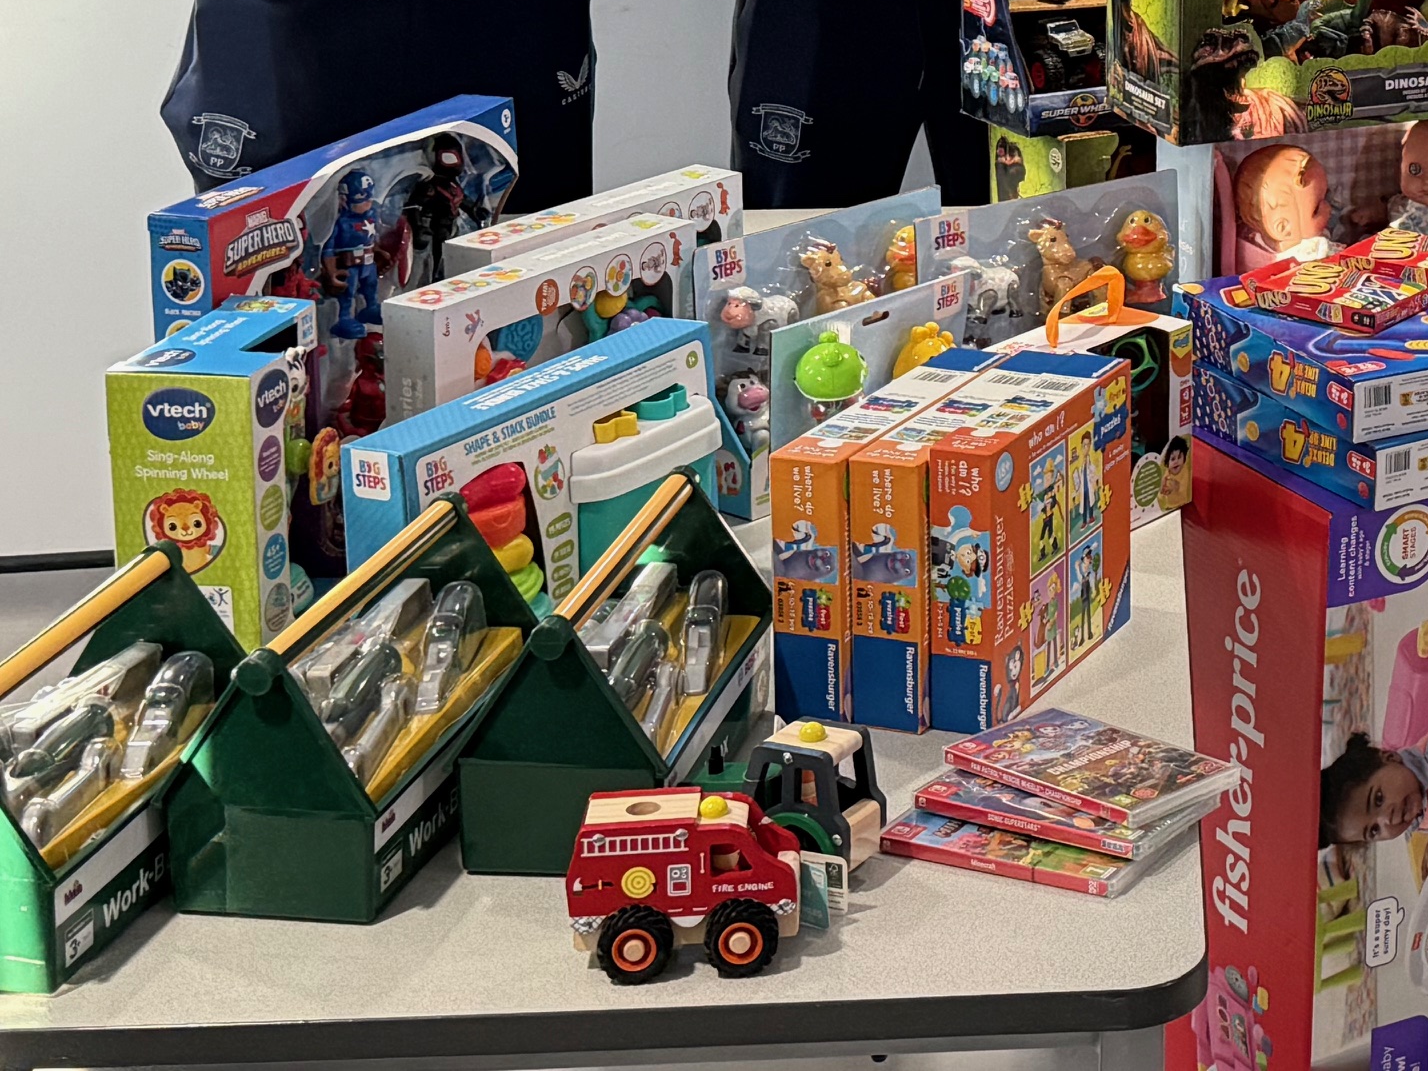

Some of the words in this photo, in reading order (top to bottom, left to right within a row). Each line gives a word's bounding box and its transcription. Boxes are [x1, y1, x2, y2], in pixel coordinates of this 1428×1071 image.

[1124, 82, 1154, 105] DINOSAUR
[1041, 106, 1079, 119] SUPER
[1308, 102, 1352, 121] DINOSAUR
[227, 231, 263, 265] SUPER
[265, 223, 294, 249] HERO
[935, 232, 966, 251] STEPS
[1371, 227, 1421, 261] UNO
[237, 245, 287, 272] ADVENTURES
[712, 260, 744, 279] STEPS
[1340, 256, 1375, 271] UNO
[1288, 261, 1345, 294] UNO
[936, 292, 960, 311] STEPS
[1257, 290, 1292, 310] UNO
[258, 380, 287, 409] vtech
[1295, 378, 1317, 398] DELUXE
[147, 402, 210, 418] vtech
[178, 421, 204, 430] baby
[464, 434, 493, 456] SHAPE
[501, 423, 526, 443] STACK
[526, 407, 557, 432] BUNDLE
[1100, 413, 1121, 439] puzzles
[1028, 430, 1043, 449] who
[147, 450, 214, 464] Sing-Along
[959, 460, 968, 479] am
[1309, 448, 1336, 467] DELUXE
[135, 466, 187, 480] Spinning
[191, 468, 229, 481] Wheel
[355, 473, 387, 490] STEPS
[424, 472, 455, 496] STEPS
[805, 465, 813, 502] where
[884, 468, 892, 503] where
[971, 467, 980, 492] who
[793, 483, 804, 512] live?
[873, 486, 884, 515] live?
[1350, 515, 1359, 558] changes
[1402, 528, 1411, 560] SMART
[1338, 536, 1348, 581] Learning
[993, 515, 1008, 647] Ravensburger
[1348, 557, 1356, 598] content
[1003, 575, 1015, 638] Puzzle
[1107, 561, 1130, 631] Ravensburger
[827, 643, 838, 712] Ravensburger
[905, 646, 915, 714] Ravensburger
[979, 664, 988, 730] Ravensburger
[1050, 740, 1133, 776] CHAMPIONSHIP
[987, 813, 1003, 824] SONIC
[1004, 816, 1038, 831] SUPERSTARS
[1101, 839, 1124, 852] SEGA
[970, 859, 996, 871] Minecraft
[712, 884, 735, 893] FIRE
[738, 882, 775, 892] ENGINE
